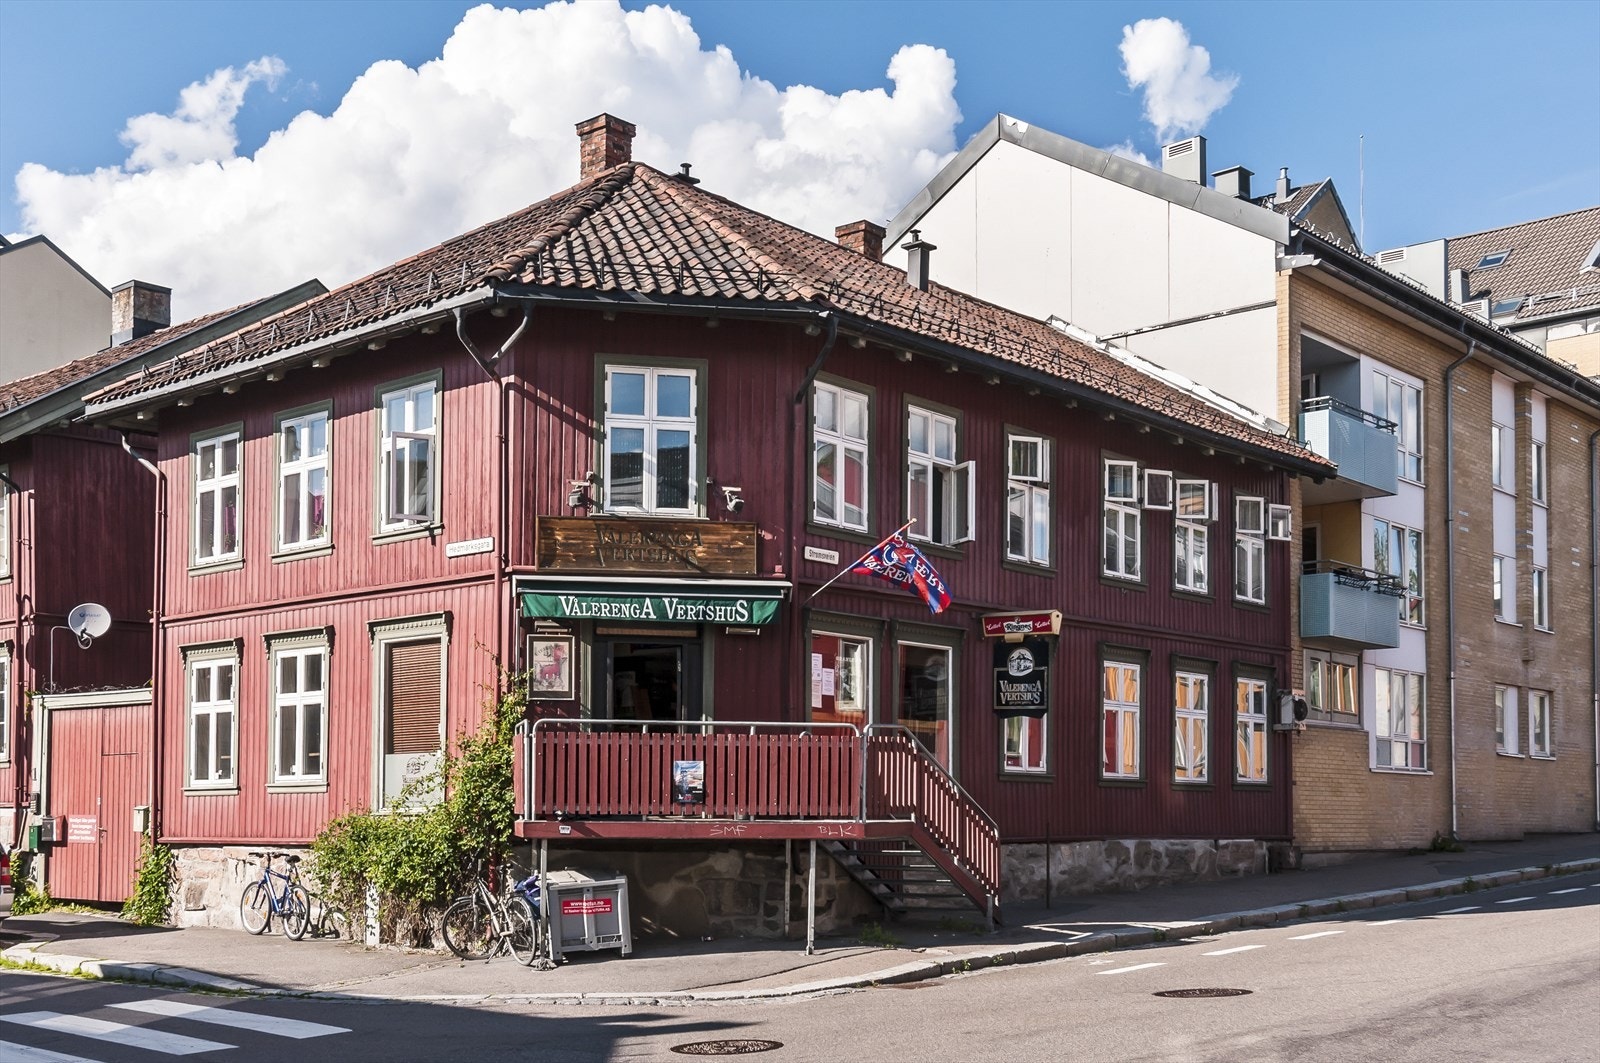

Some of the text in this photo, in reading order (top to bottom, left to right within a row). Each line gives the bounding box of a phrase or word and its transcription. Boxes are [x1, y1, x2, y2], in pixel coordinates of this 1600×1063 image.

[558, 595, 749, 623] VÅLERENGA VERTSHUS
[1000, 692, 1040, 704] VERTSHUS
